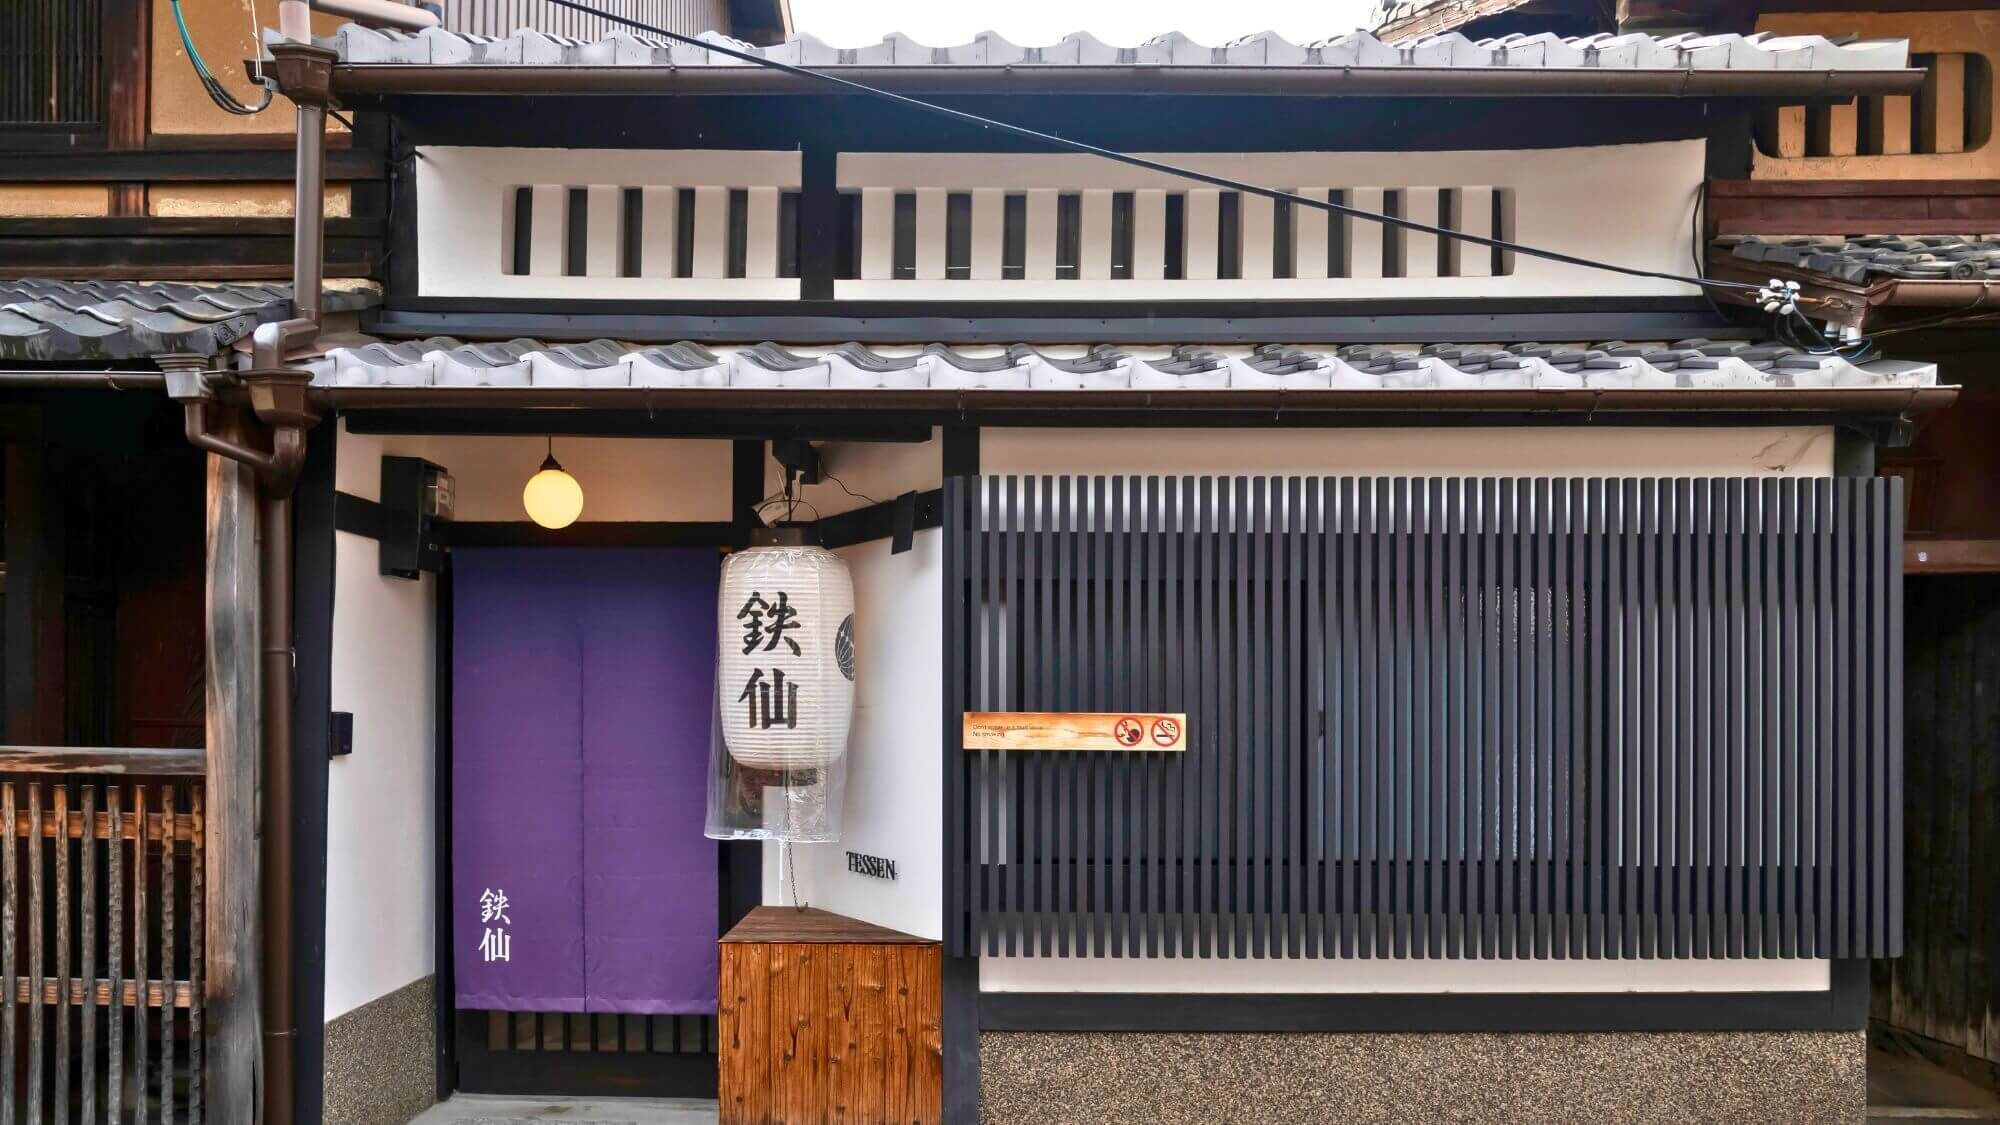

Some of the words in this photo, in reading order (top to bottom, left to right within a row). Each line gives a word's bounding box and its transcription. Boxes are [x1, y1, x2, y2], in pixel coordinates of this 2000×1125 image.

[737, 591, 802, 729] 鉄仙
[846, 851, 895, 880] TESSEN
[478, 888, 511, 962] 鉄仙
